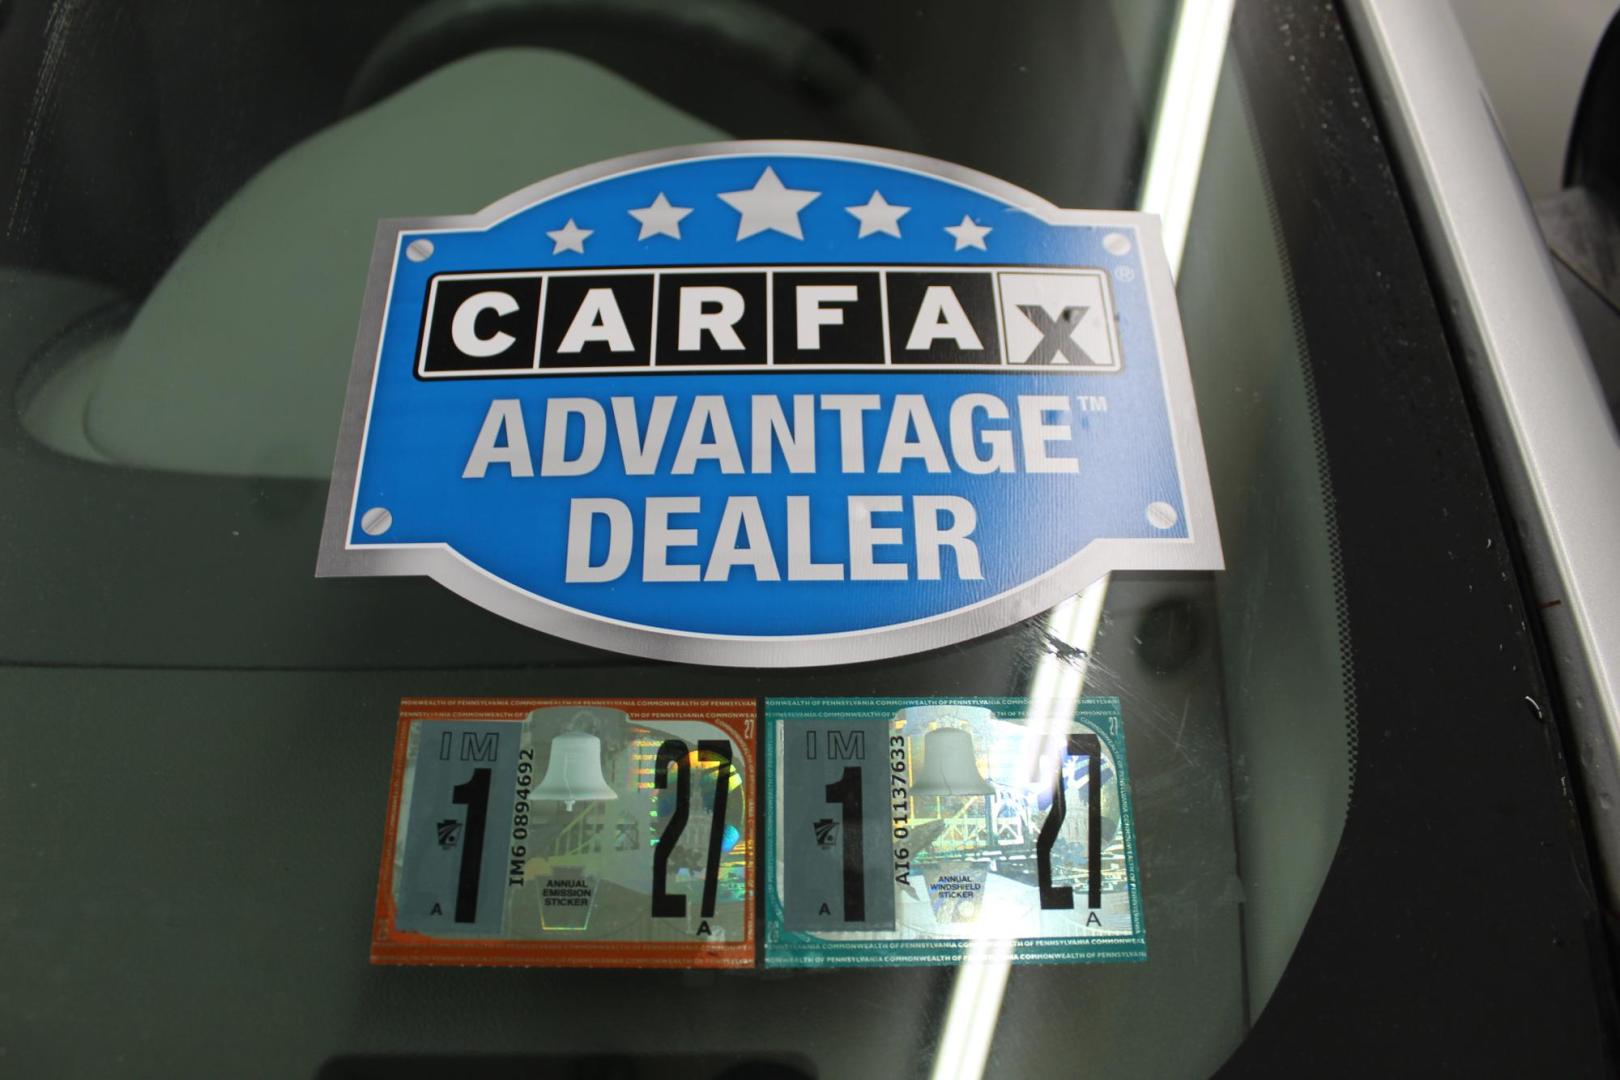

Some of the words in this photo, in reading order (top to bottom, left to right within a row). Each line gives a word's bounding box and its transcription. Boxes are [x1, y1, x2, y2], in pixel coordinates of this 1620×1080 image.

[451, 285, 1097, 365] CARFAX
[462, 392, 1081, 479] ADVANTAGE
[565, 495, 985, 584] DEALER
[440, 731, 499, 762] IM
[806, 730, 866, 761] IM
[512, 748, 534, 840] 0894692
[890, 735, 909, 840] 01137633
[652, 739, 733, 919] 27
[825, 766, 866, 922] 1
[452, 767, 491, 923] 1
[508, 845, 527, 887] IM6
[894, 848, 910, 886] AI6
[938, 875, 971, 883] ANNUAL
[543, 888, 592, 897] EMISSION
[546, 879, 588, 888] ANNUAL
[938, 890, 974, 899] STICKER
[429, 902, 443, 916] A
[544, 897, 588, 906] STICKER
[819, 902, 831, 917] A
[696, 920, 712, 936] A
[1085, 911, 1103, 928] A
